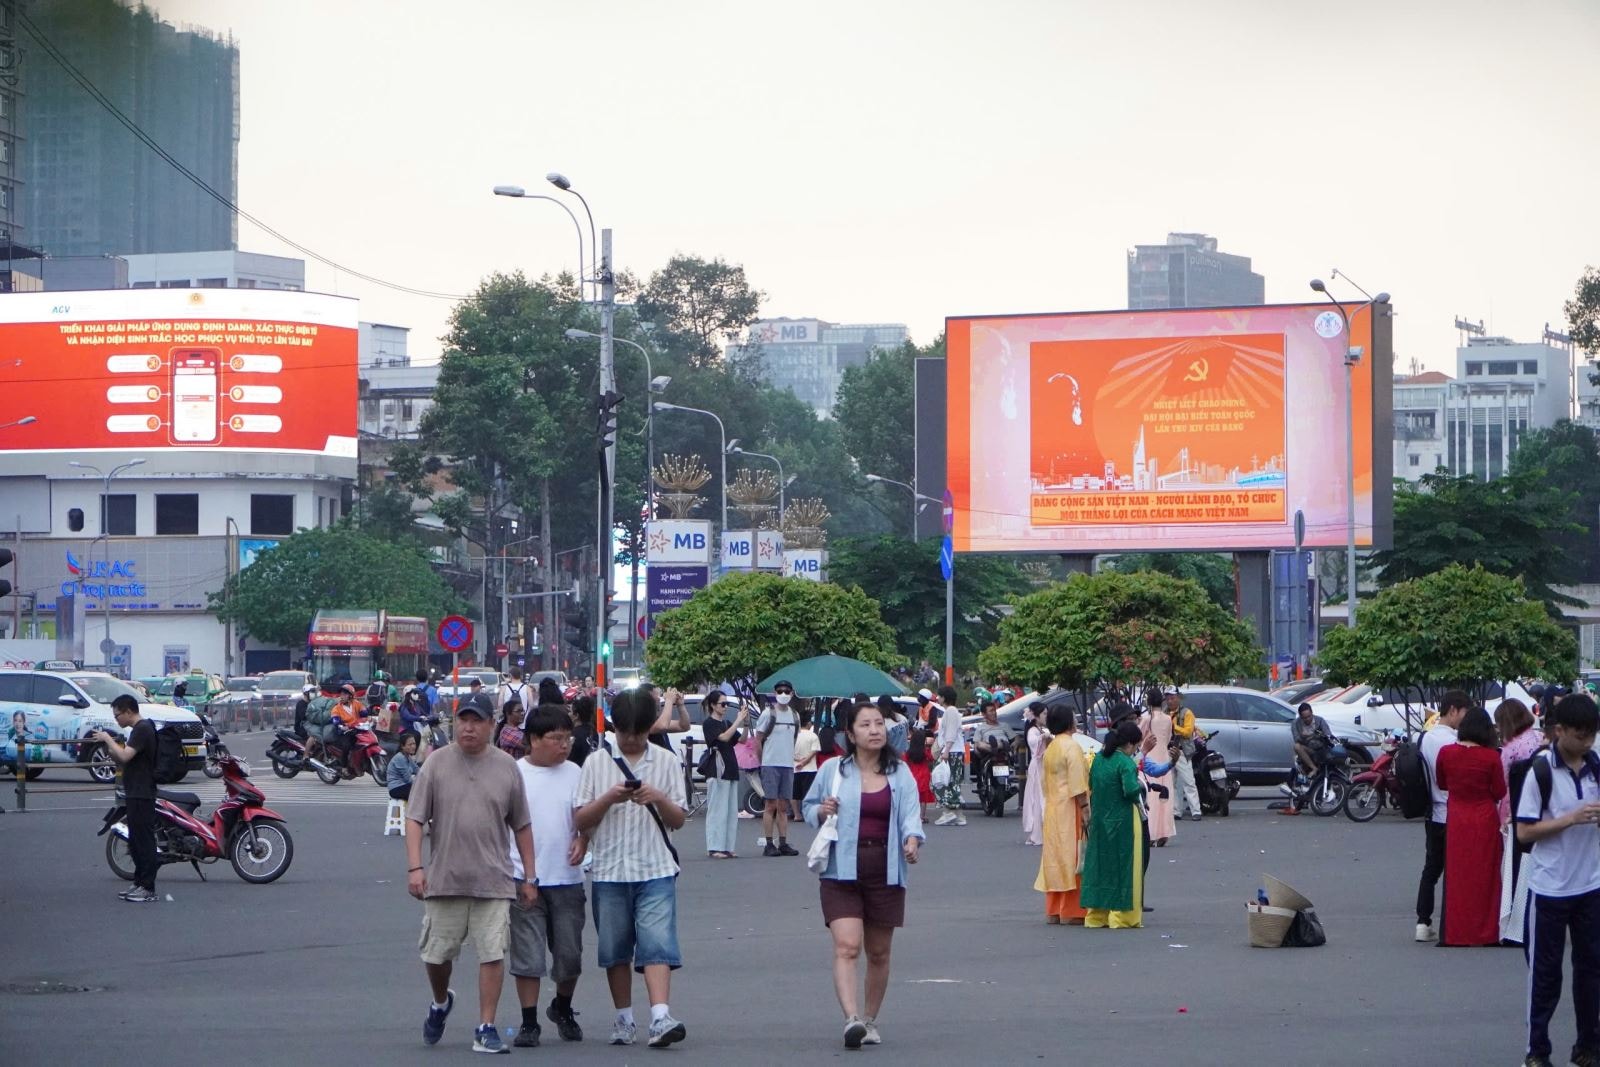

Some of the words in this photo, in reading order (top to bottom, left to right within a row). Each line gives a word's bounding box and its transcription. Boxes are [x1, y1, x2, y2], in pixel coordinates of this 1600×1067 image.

[84, 324, 105, 333] KHAI
[127, 322, 150, 333] PHÁP
[174, 323, 200, 333] DỤNG
[256, 323, 273, 332] XÁC
[781, 325, 807, 340] MB
[66, 335, 78, 344] VÀ
[127, 335, 147, 343] SINH
[174, 335, 195, 344] HỌC
[198, 335, 223, 345] PHỤC
[1060, 496, 1085, 509] CỘNG
[1106, 495, 1126, 508] VIỆT
[1128, 496, 1149, 506] NAM
[1150, 507, 1174, 518] CÁCH
[1176, 508, 1203, 520] MẠNG
[1205, 506, 1226, 519] VIỆT
[1228, 507, 1249, 517] NAM
[674, 533, 706, 549] MB
[729, 541, 750, 556] MB
[775, 542, 784, 555] M
[794, 559, 819, 572] MB
[660, 588, 676, 596] HẠNH
